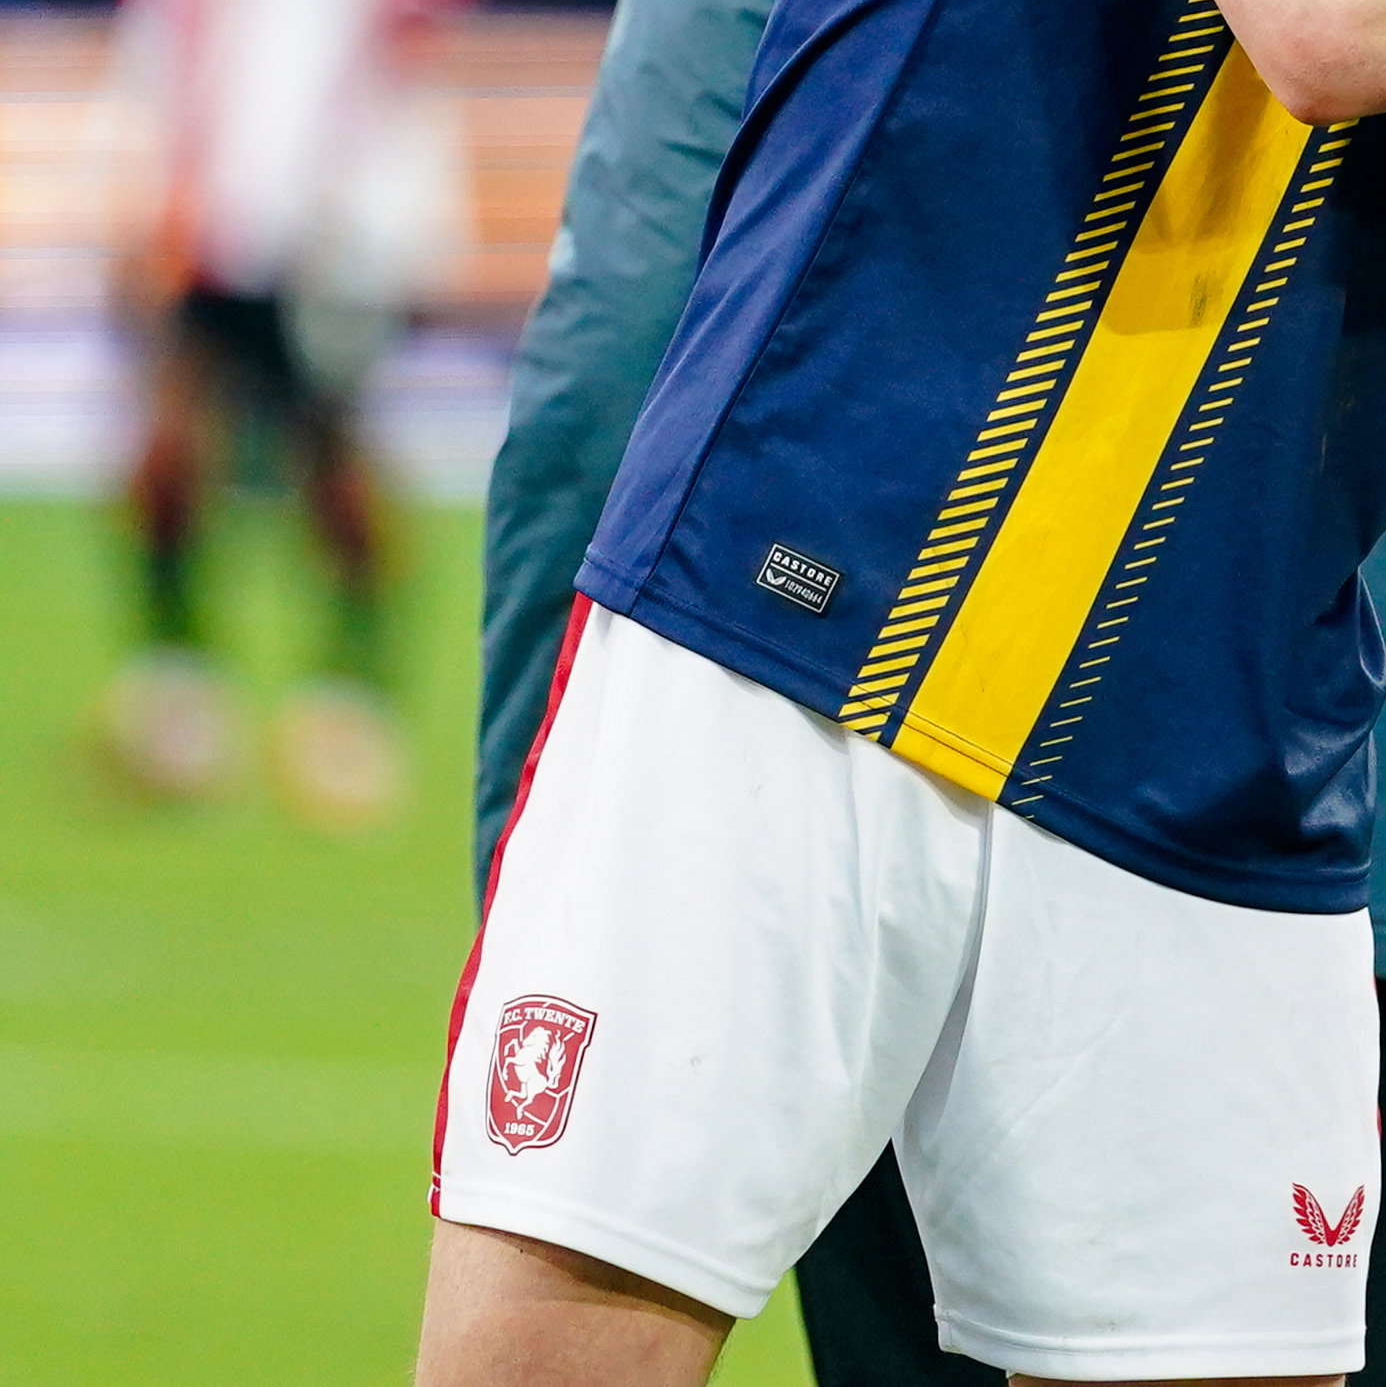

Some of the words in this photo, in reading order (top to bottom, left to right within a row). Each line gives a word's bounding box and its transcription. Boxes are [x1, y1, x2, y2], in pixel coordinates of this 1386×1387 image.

[772, 551, 833, 587] CASTORE
[524, 1006, 586, 1034] TWENTE
[504, 1122, 536, 1136] 1965
[1289, 1252, 1358, 1268] CASTORE
